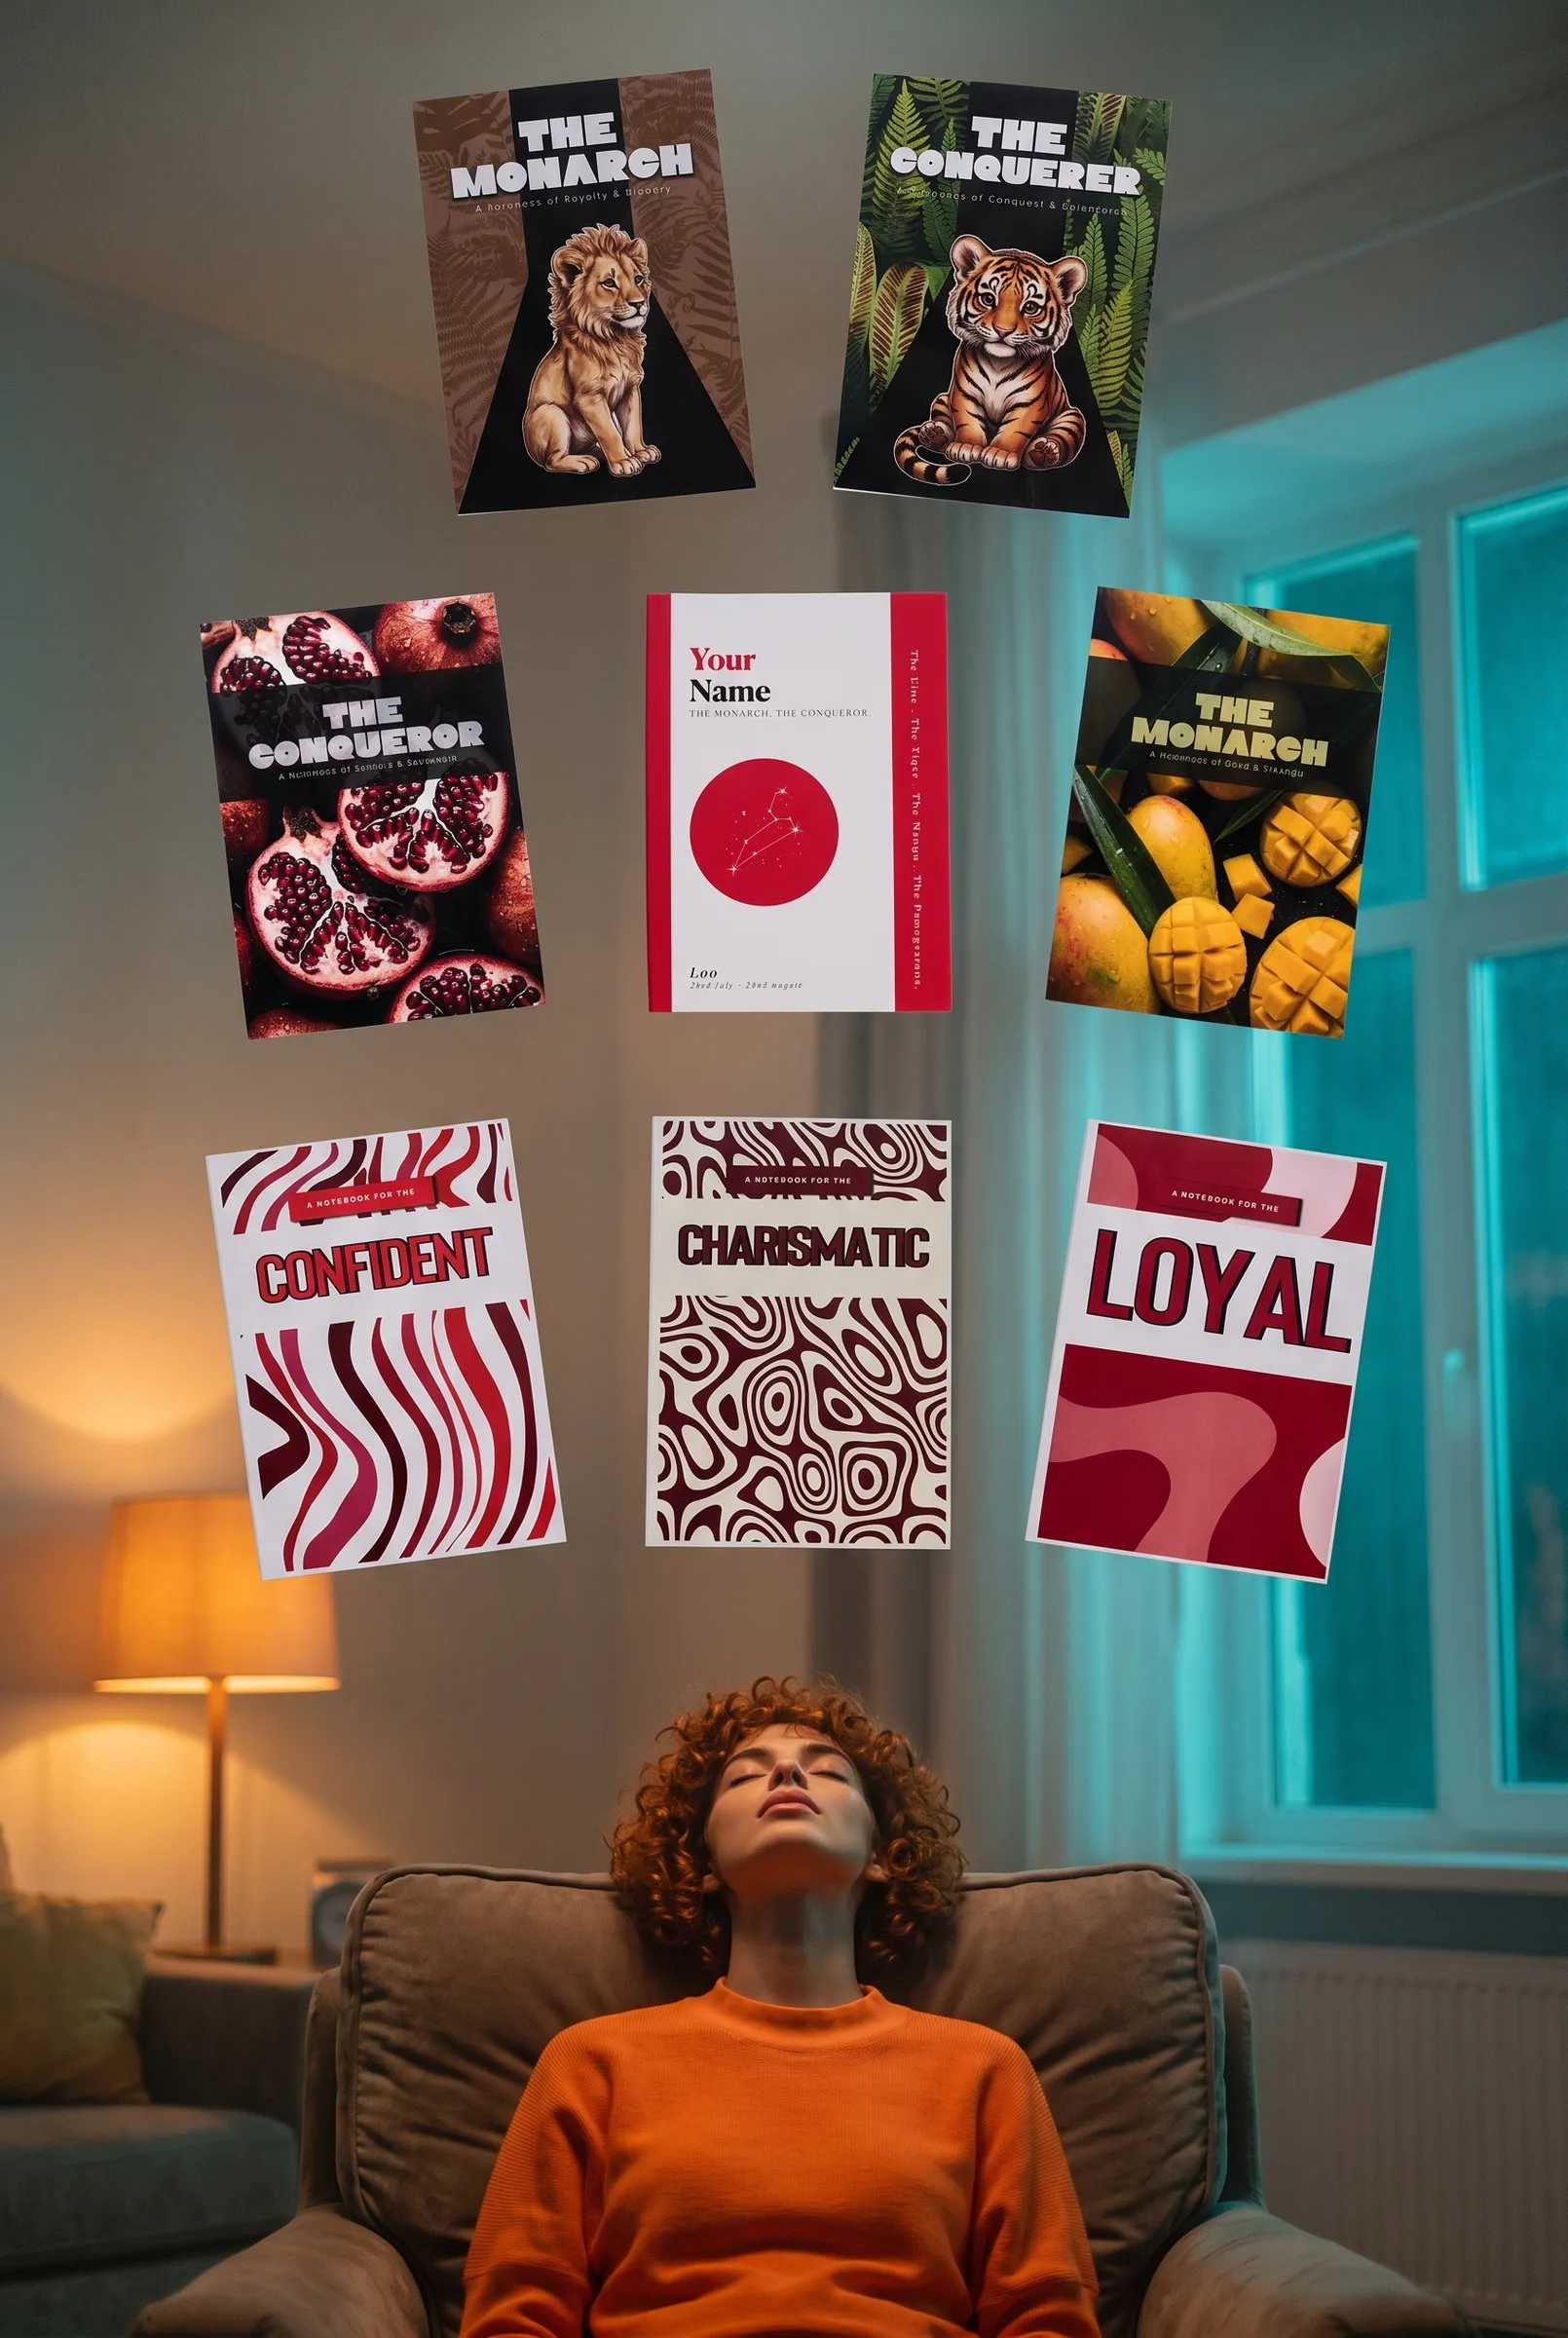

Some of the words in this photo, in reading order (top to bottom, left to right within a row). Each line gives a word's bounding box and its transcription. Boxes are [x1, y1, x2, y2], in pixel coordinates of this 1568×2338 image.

[518, 112, 617, 153] THE
[971, 115, 1068, 155] THE
[450, 142, 694, 199] MONARCH
[890, 146, 1140, 195] CONQUERER
[546, 196, 558, 206] of
[613, 189, 619, 198] &
[971, 194, 984, 203] of
[988, 195, 1044, 209] Conquest
[1049, 201, 1056, 209] &
[689, 647, 757, 671] Your
[910, 650, 918, 671] The
[689, 679, 771, 702] Name
[322, 697, 403, 730] THE
[689, 709, 710, 718] THE
[1195, 693, 1275, 728] THE
[911, 718, 919, 740] The
[1131, 716, 1329, 767] MONARCH
[248, 720, 485, 770] CONQUEROR
[912, 793, 920, 816] The
[690, 967, 718, 979] Loo
[317, 1194, 370, 1208] NOTEBOOK
[374, 1191, 392, 1200] FOR
[396, 1188, 415, 1197] THE
[1180, 1190, 1235, 1206] NOTEBOOK
[1238, 1199, 1257, 1209] FOR
[1261, 1203, 1280, 1213] THE
[678, 1224, 930, 1268] CHARISMATIC
[255, 1226, 494, 1303] CONFIDENT
[1086, 1227, 1353, 1354] LOYAL
